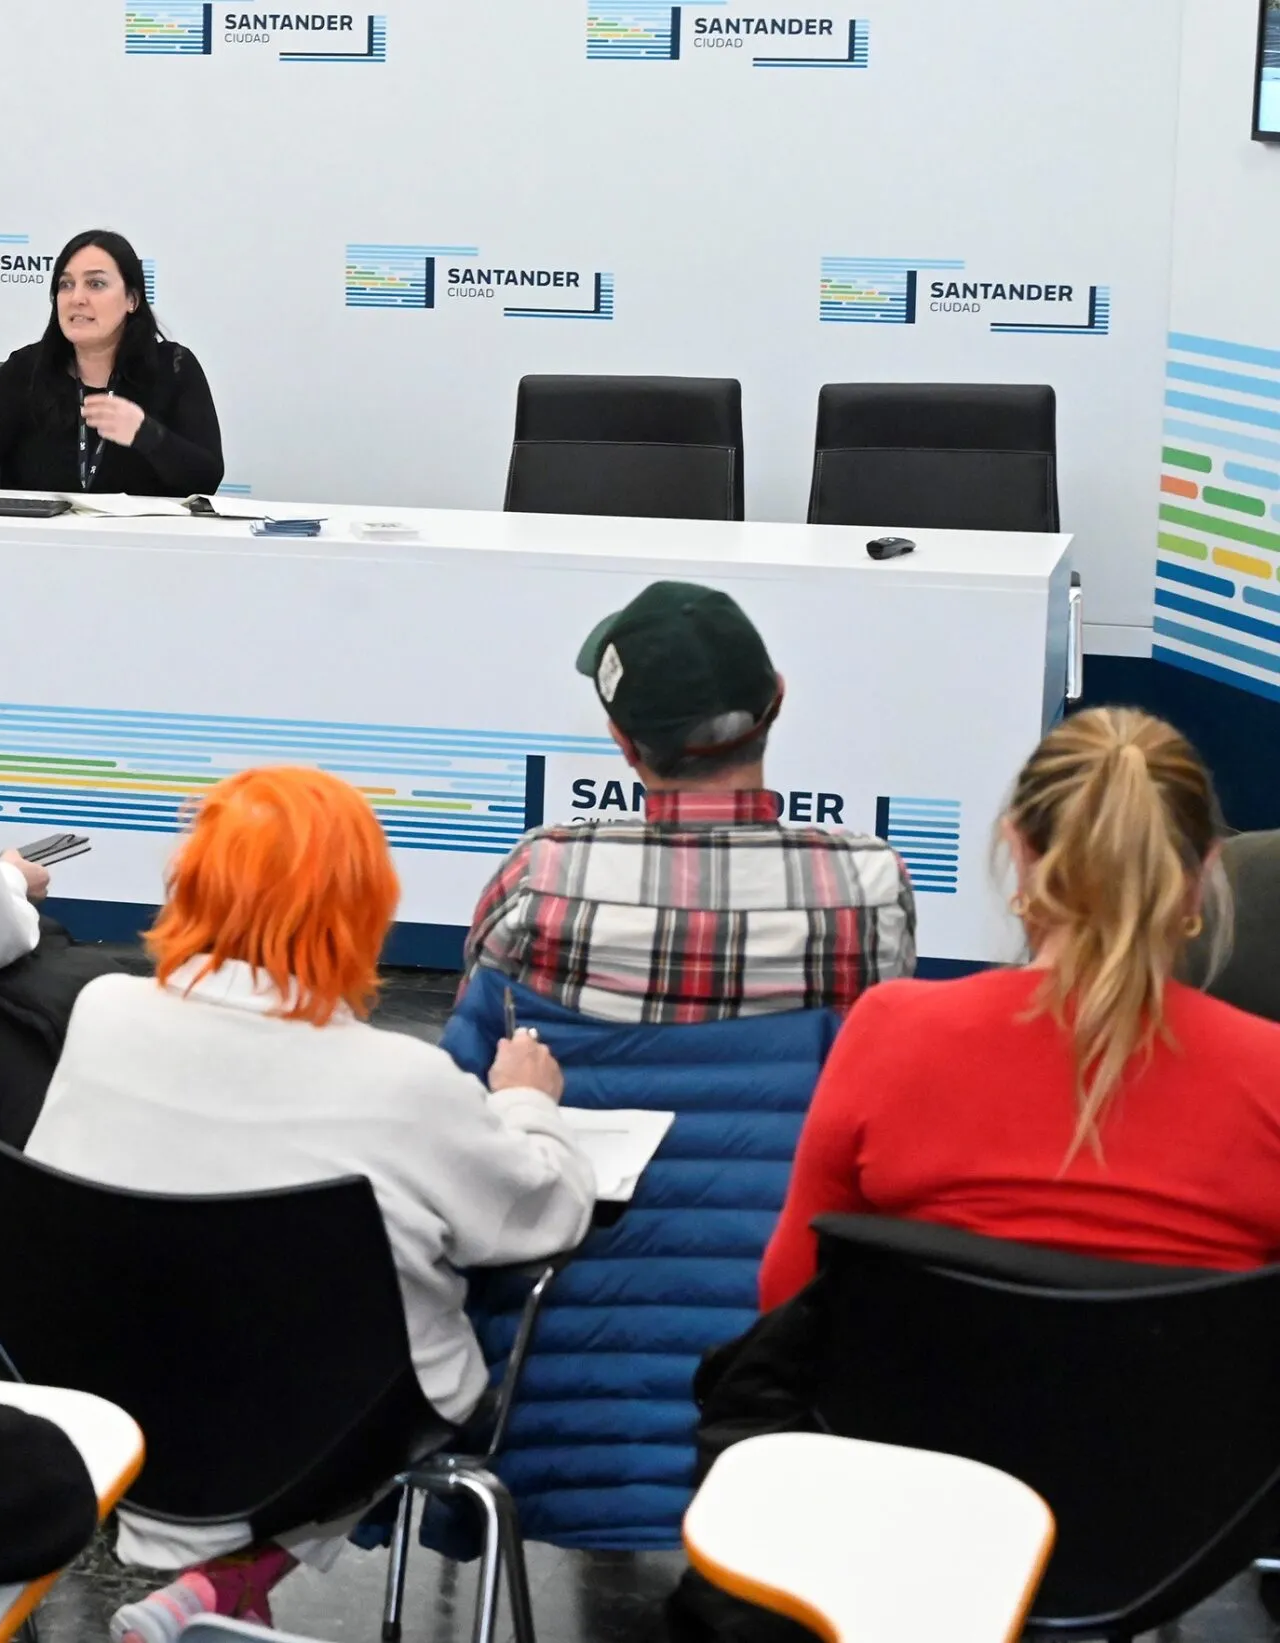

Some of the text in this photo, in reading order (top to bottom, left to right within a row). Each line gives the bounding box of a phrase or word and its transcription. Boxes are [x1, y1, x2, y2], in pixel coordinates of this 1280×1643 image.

[224, 14, 353, 31] SANTANDER
[694, 18, 833, 36] SANTANDER
[224, 33, 270, 43] CIUDAD
[693, 38, 743, 48] CIUDAD
[0, 273, 44, 284] CIUDAD
[447, 268, 580, 288] SANTANDER
[447, 287, 495, 298] CIUDAD
[930, 282, 1073, 302] SANTANDER
[929, 302, 981, 313] CIUDAD
